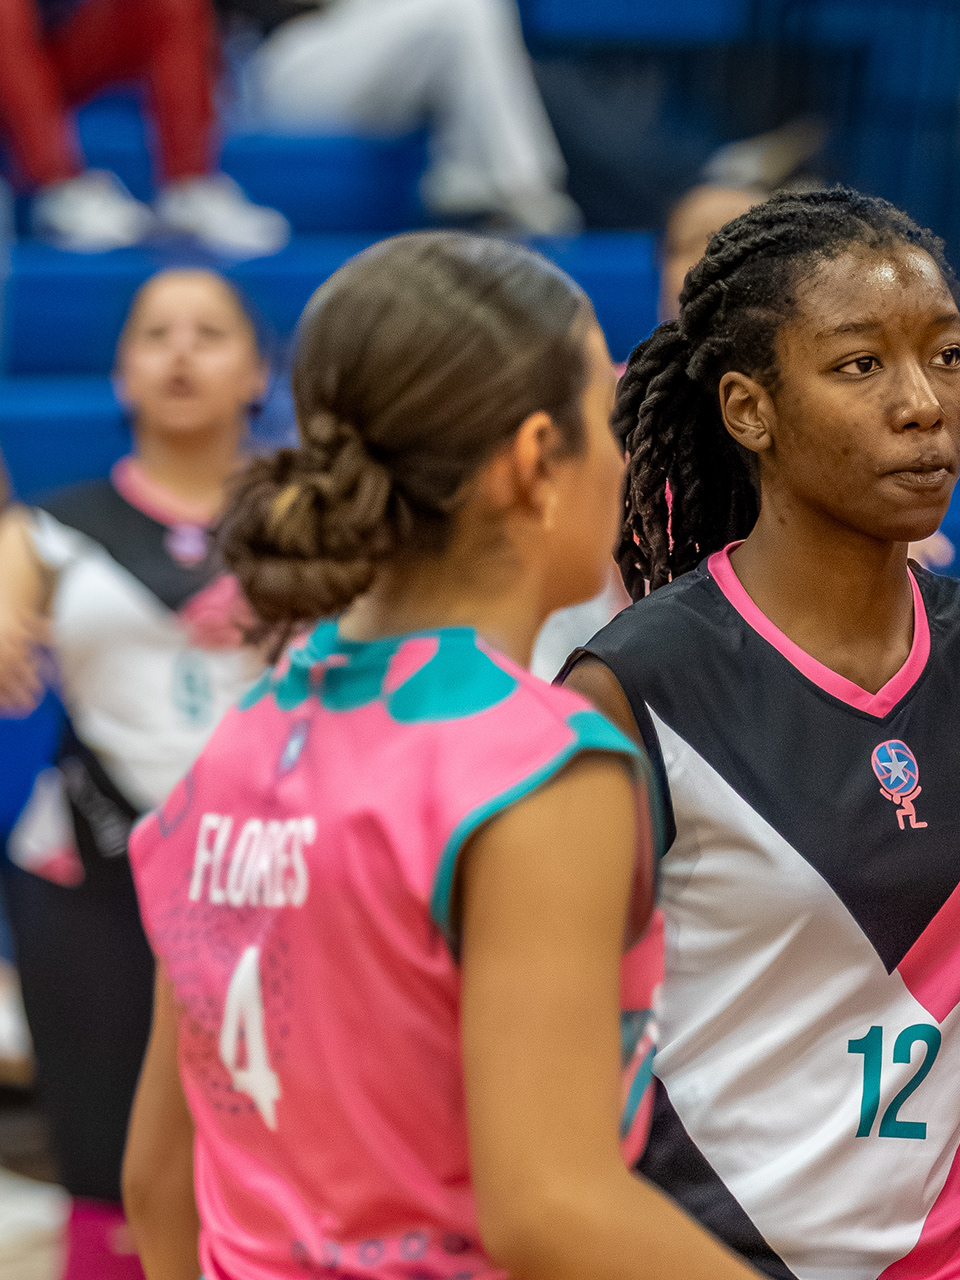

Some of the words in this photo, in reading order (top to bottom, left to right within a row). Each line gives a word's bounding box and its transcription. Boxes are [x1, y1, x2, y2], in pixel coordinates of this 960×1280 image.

[188, 812, 317, 908] FLORES
[218, 945, 282, 1132] 4
[847, 1023, 942, 1140] 12
